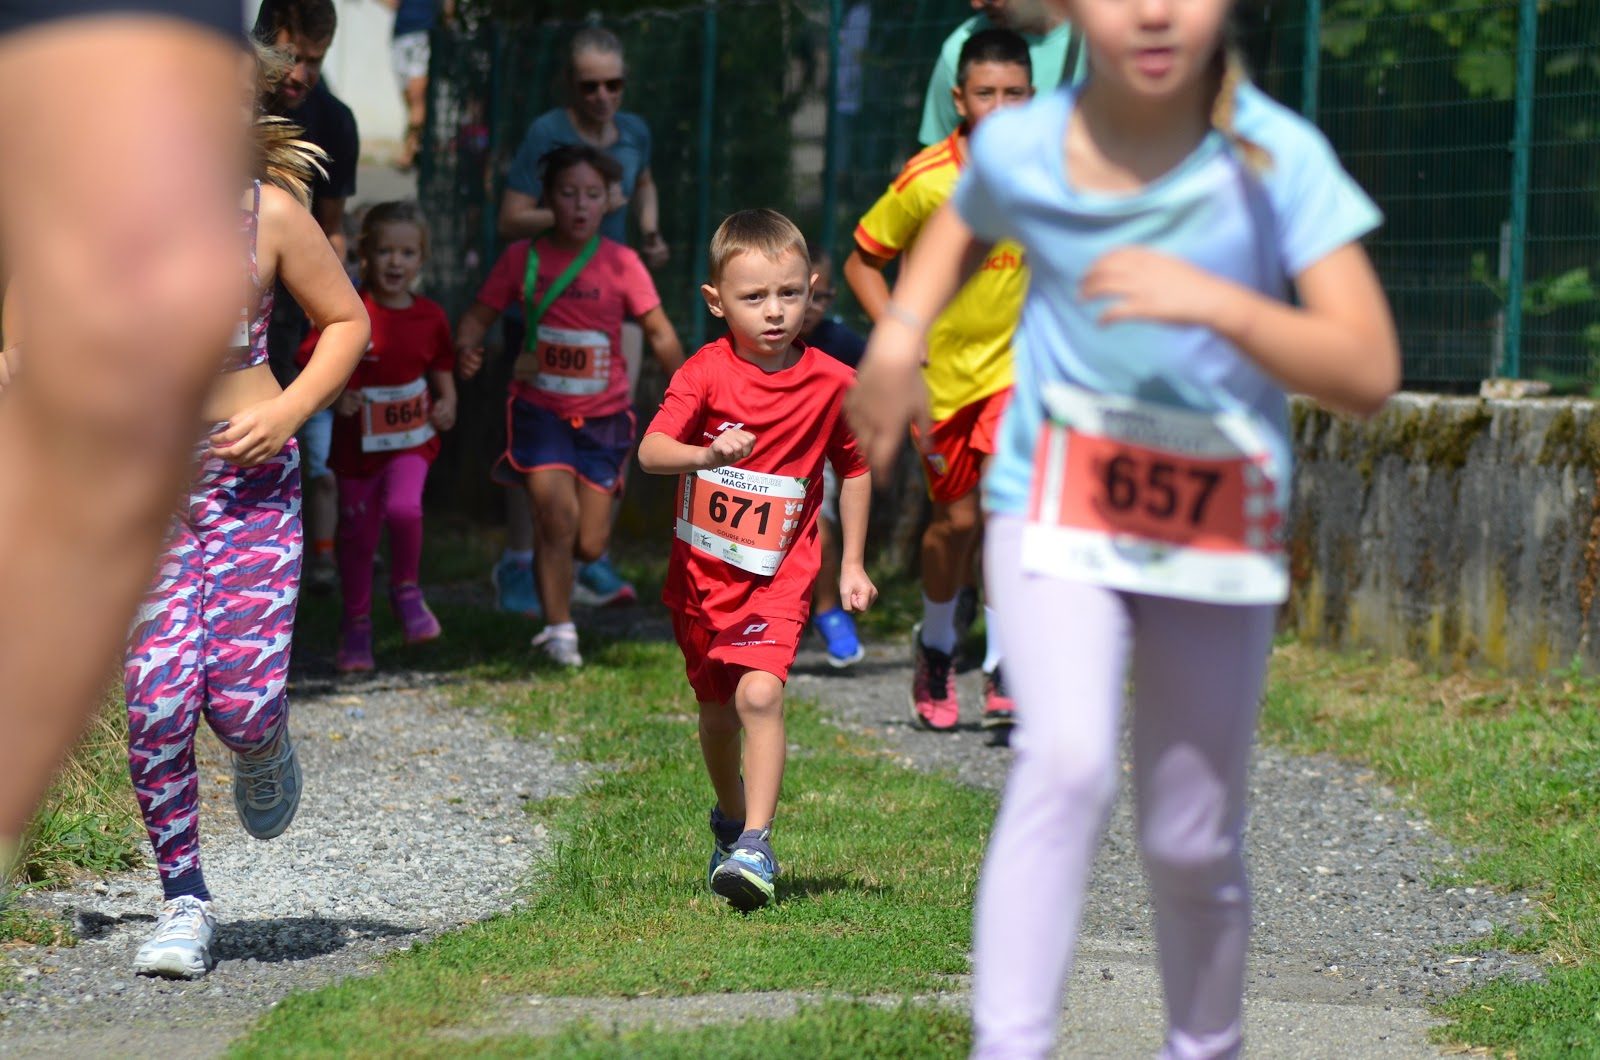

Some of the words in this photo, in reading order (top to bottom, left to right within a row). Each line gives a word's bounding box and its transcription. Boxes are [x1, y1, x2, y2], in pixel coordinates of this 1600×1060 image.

[544, 346, 587, 370] 690
[384, 400, 421, 426] 664
[708, 467, 745, 480] OURSES
[721, 477, 769, 493] MAGSTATT
[1104, 453, 1223, 527] 657
[708, 491, 771, 535] 671
[740, 537, 755, 546] KIDS
